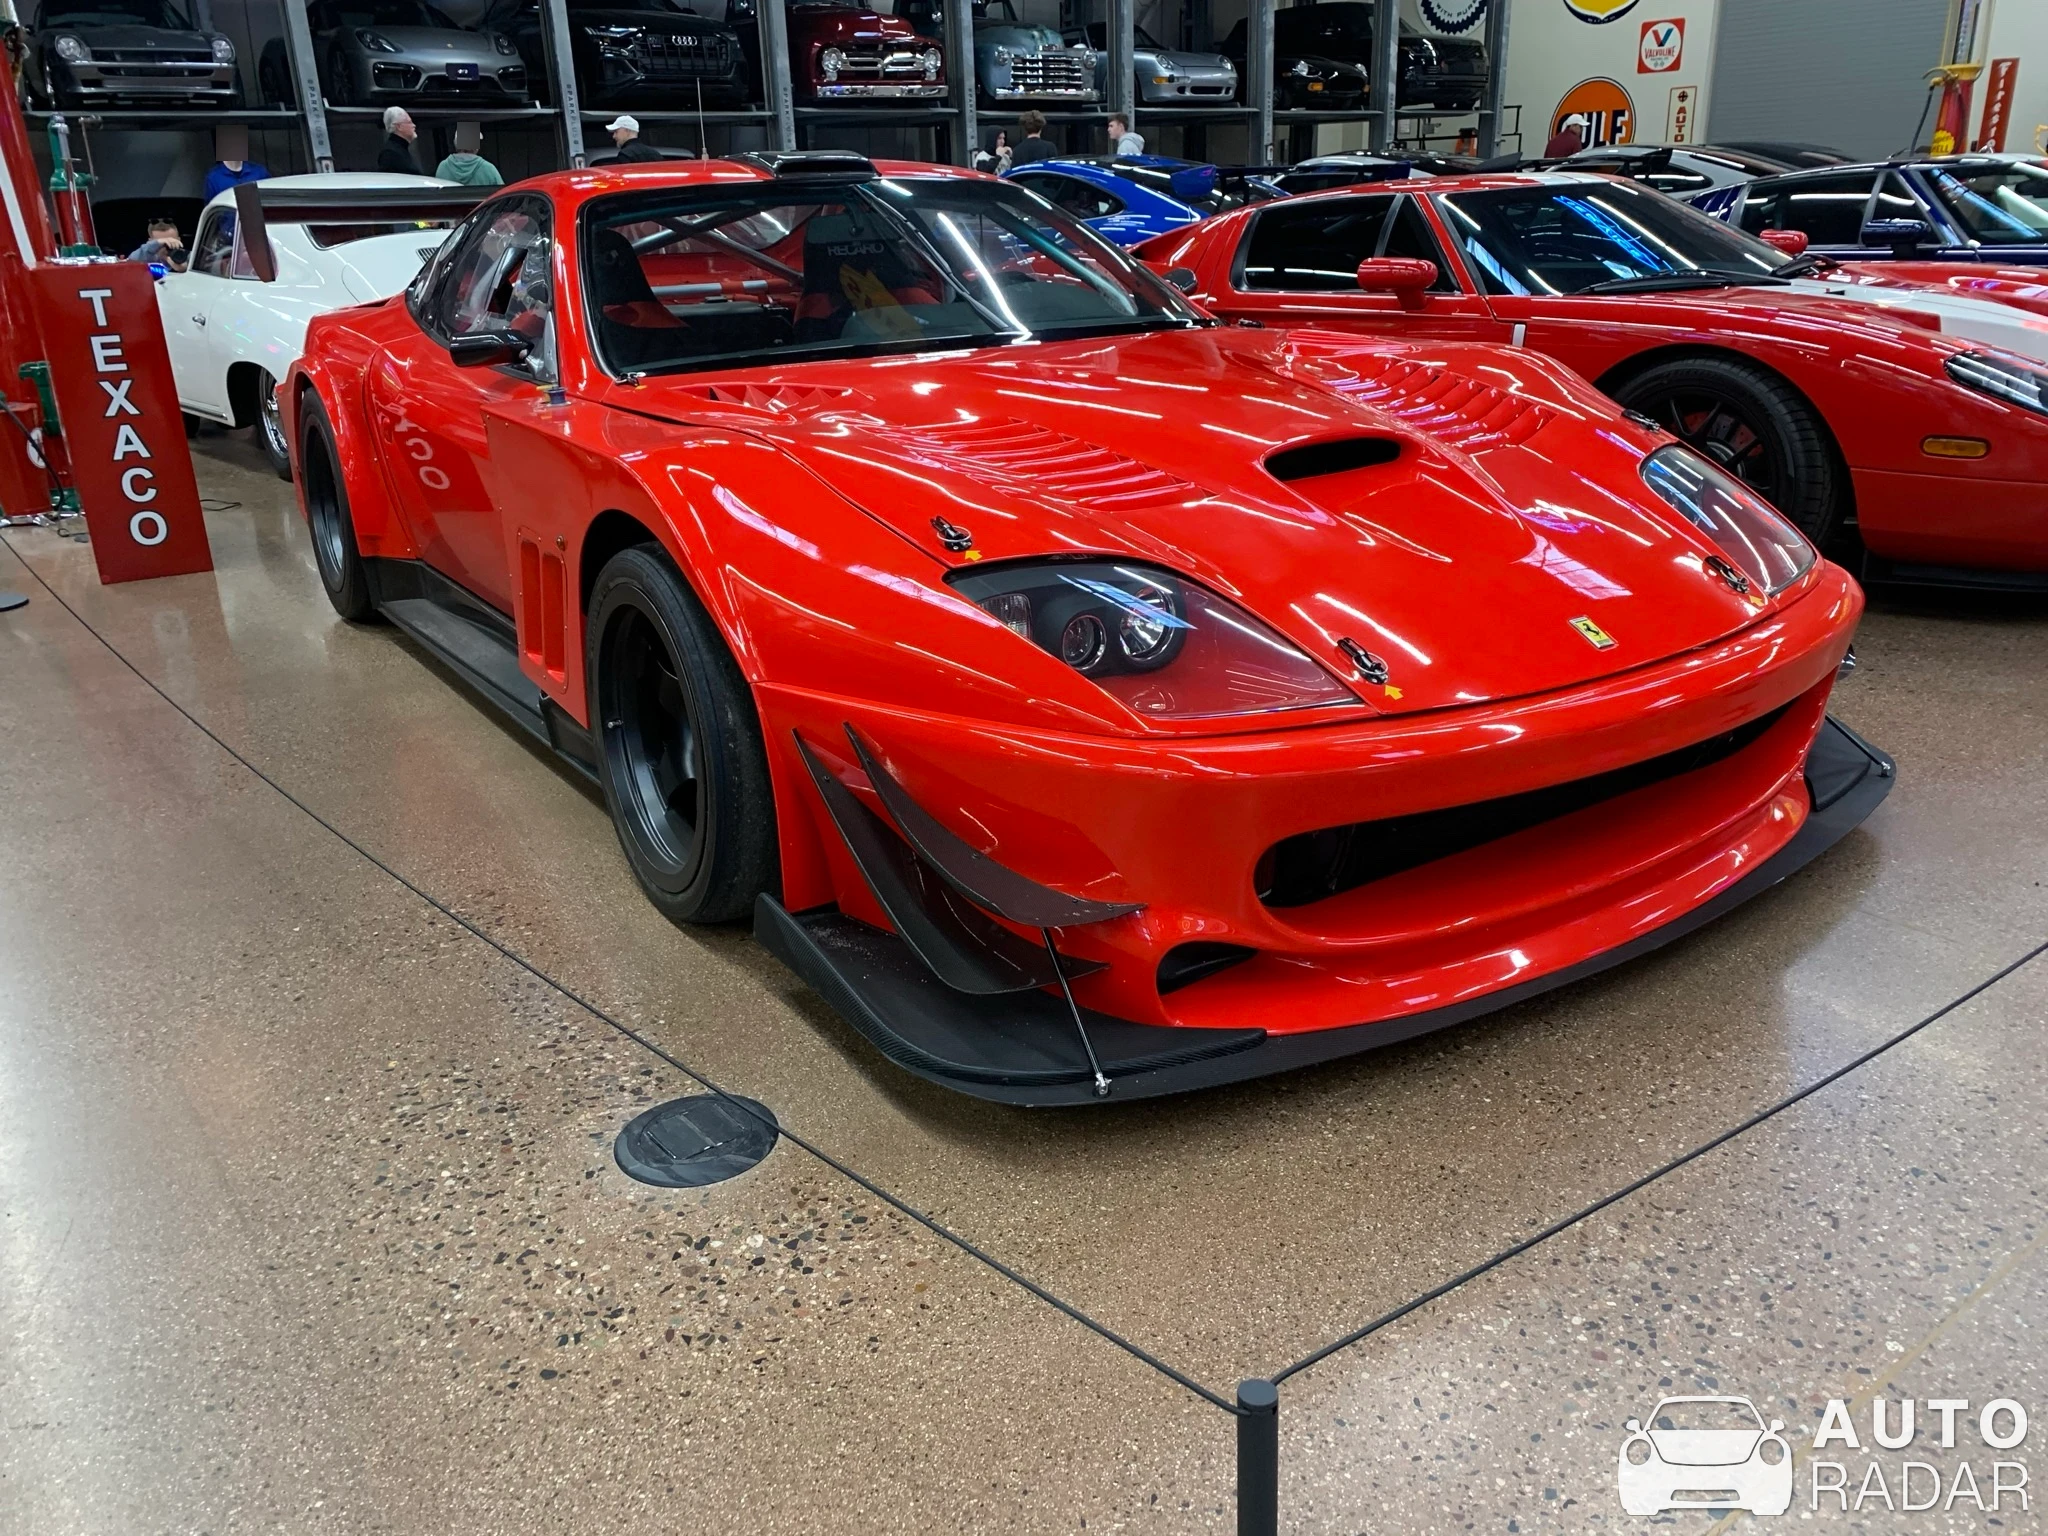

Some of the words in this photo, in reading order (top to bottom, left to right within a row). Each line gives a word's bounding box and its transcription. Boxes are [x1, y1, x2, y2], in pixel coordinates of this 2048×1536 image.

[1644, 45, 1676, 59] VALVOLINE
[1674, 106, 1687, 142] AUTO
[827, 242, 885, 257] RECARO
[79, 288, 169, 547] TEXACO
